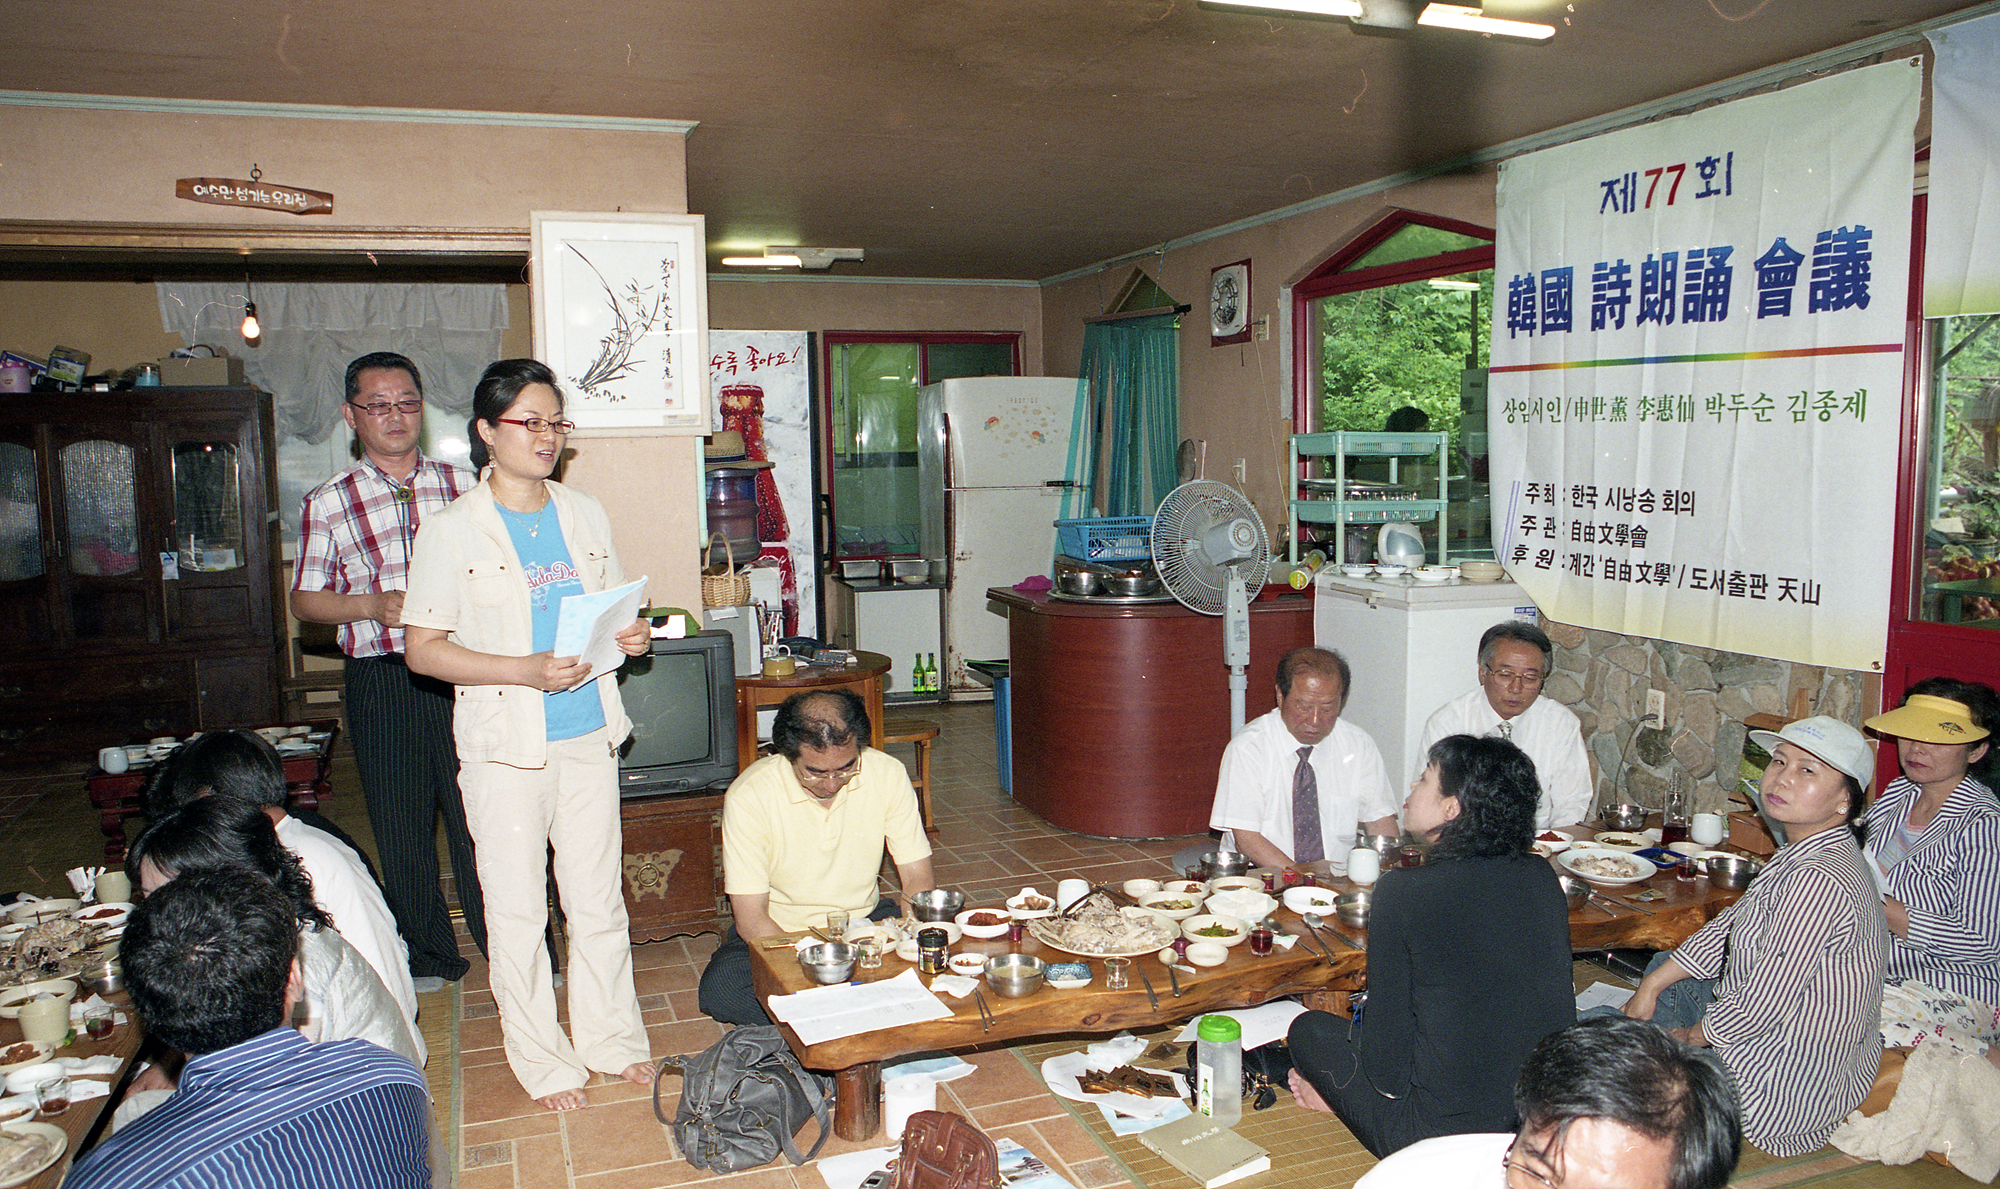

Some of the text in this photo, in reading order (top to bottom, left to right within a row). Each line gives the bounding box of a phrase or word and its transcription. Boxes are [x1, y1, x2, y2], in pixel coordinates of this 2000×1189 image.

[193, 184, 233, 200] 예수만
[272, 190, 307, 207] 우리집
[1507, 225, 1873, 340] 韓國 詩朗誦 會議
[709, 345, 801, 376] 수록 좋아요!
[1705, 392, 1776, 424] 박두순
[1786, 388, 1868, 424] 김종제
[1571, 484, 1598, 510] 한국
[1605, 486, 1656, 514] 시낭송
[1662, 489, 1696, 517] 회의
[1571, 519, 1649, 549] 自由文學會
[1569, 552, 1595, 578] 계간
[1689, 567, 1769, 600] 도서출판
[1777, 576, 1821, 606] 天山
